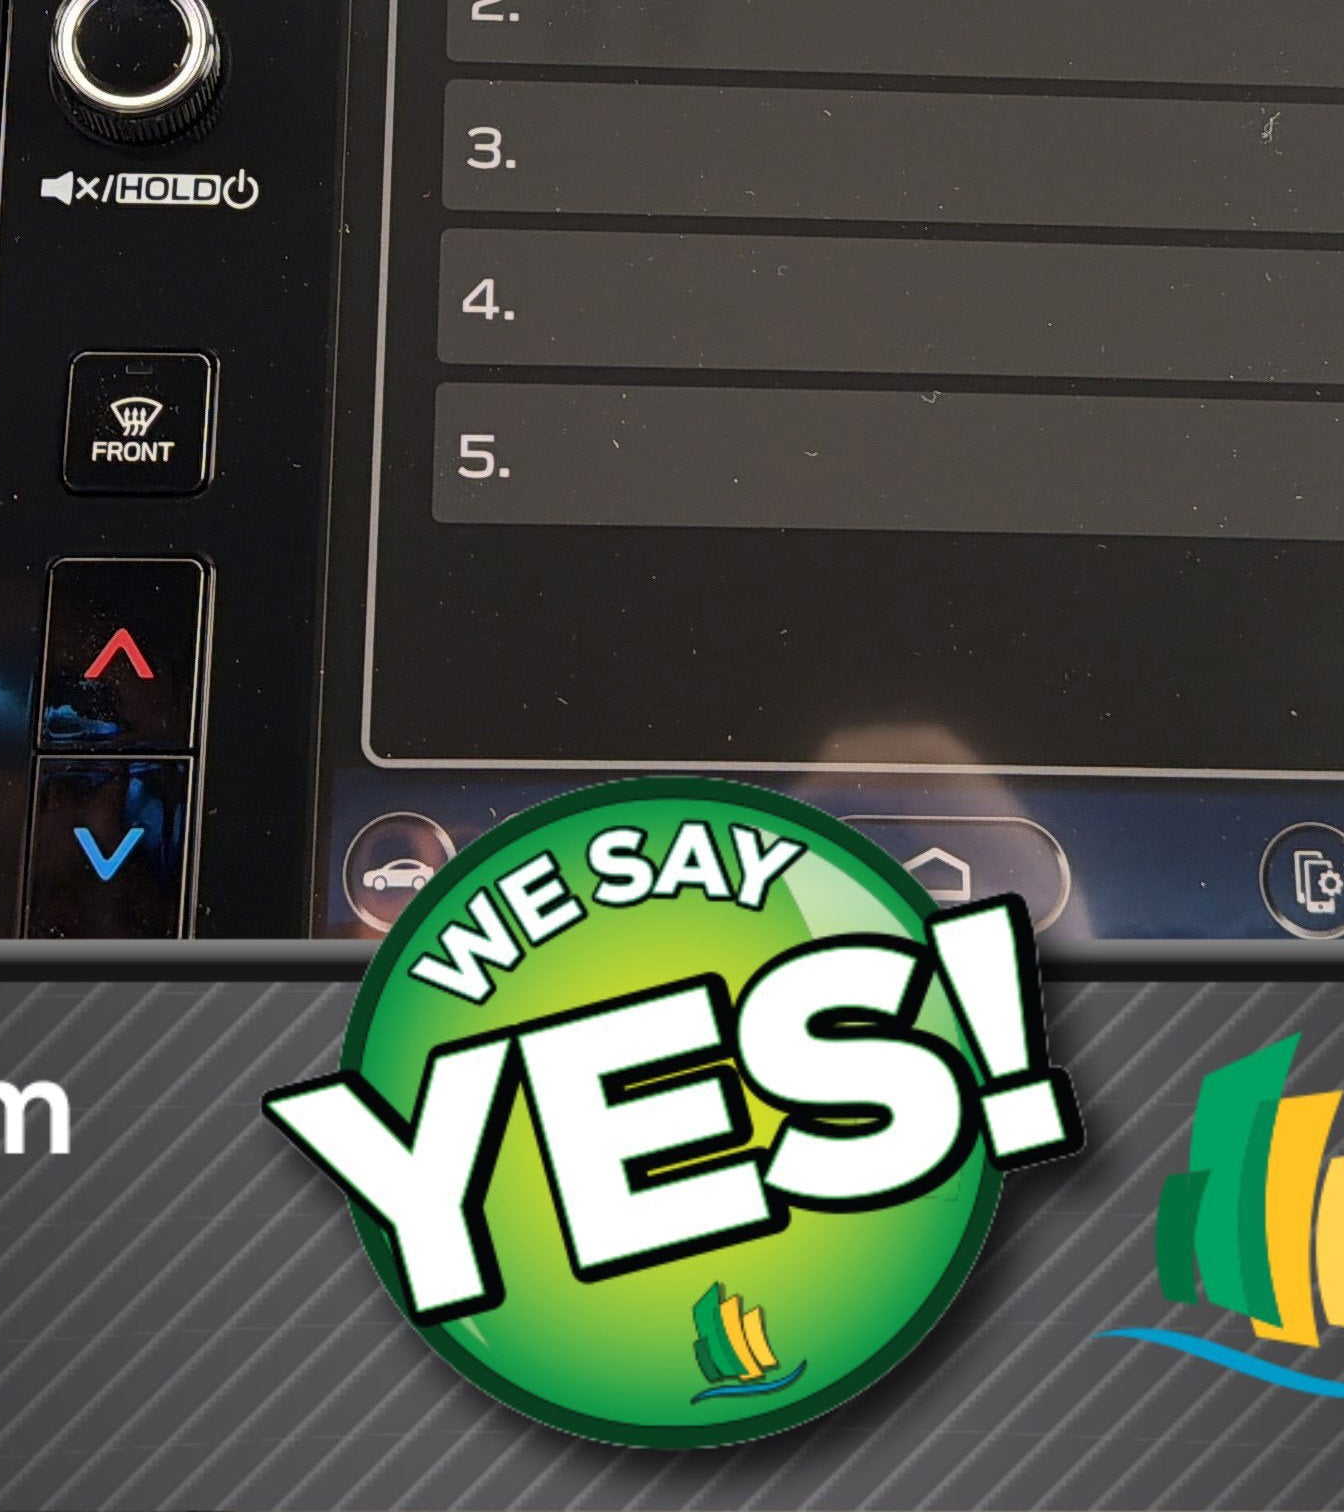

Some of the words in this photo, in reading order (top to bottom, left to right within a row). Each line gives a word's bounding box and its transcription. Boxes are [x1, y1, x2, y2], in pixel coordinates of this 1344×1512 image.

[466, 126, 516, 170] 3.
[118, 175, 219, 203] HOLD
[462, 278, 515, 321] 4.
[91, 441, 176, 462] FRONT
[457, 434, 510, 479] 5.
